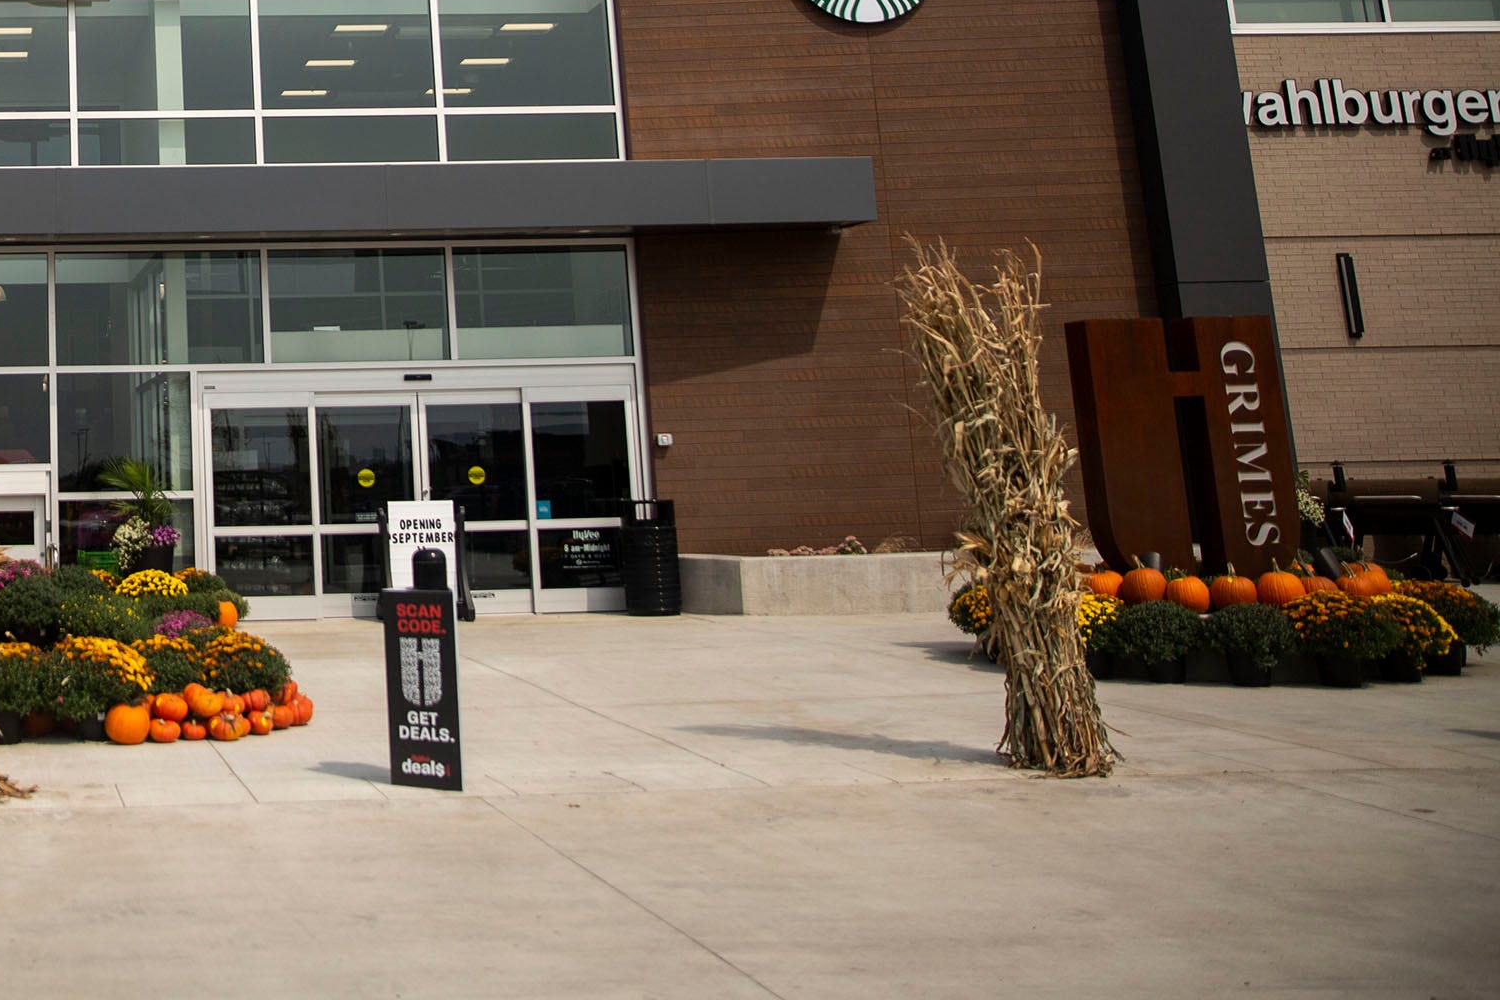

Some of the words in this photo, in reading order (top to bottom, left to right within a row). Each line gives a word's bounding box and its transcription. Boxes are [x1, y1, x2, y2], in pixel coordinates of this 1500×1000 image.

[1220, 341, 1281, 547] GRIMES
[399, 518, 442, 530] OPENING
[392, 531, 454, 544] SEPTEMBER
[395, 603, 442, 618] SCAN
[397, 619, 447, 635] CODE.
[407, 710, 440, 726] GET
[399, 725, 456, 743] DEALS.
